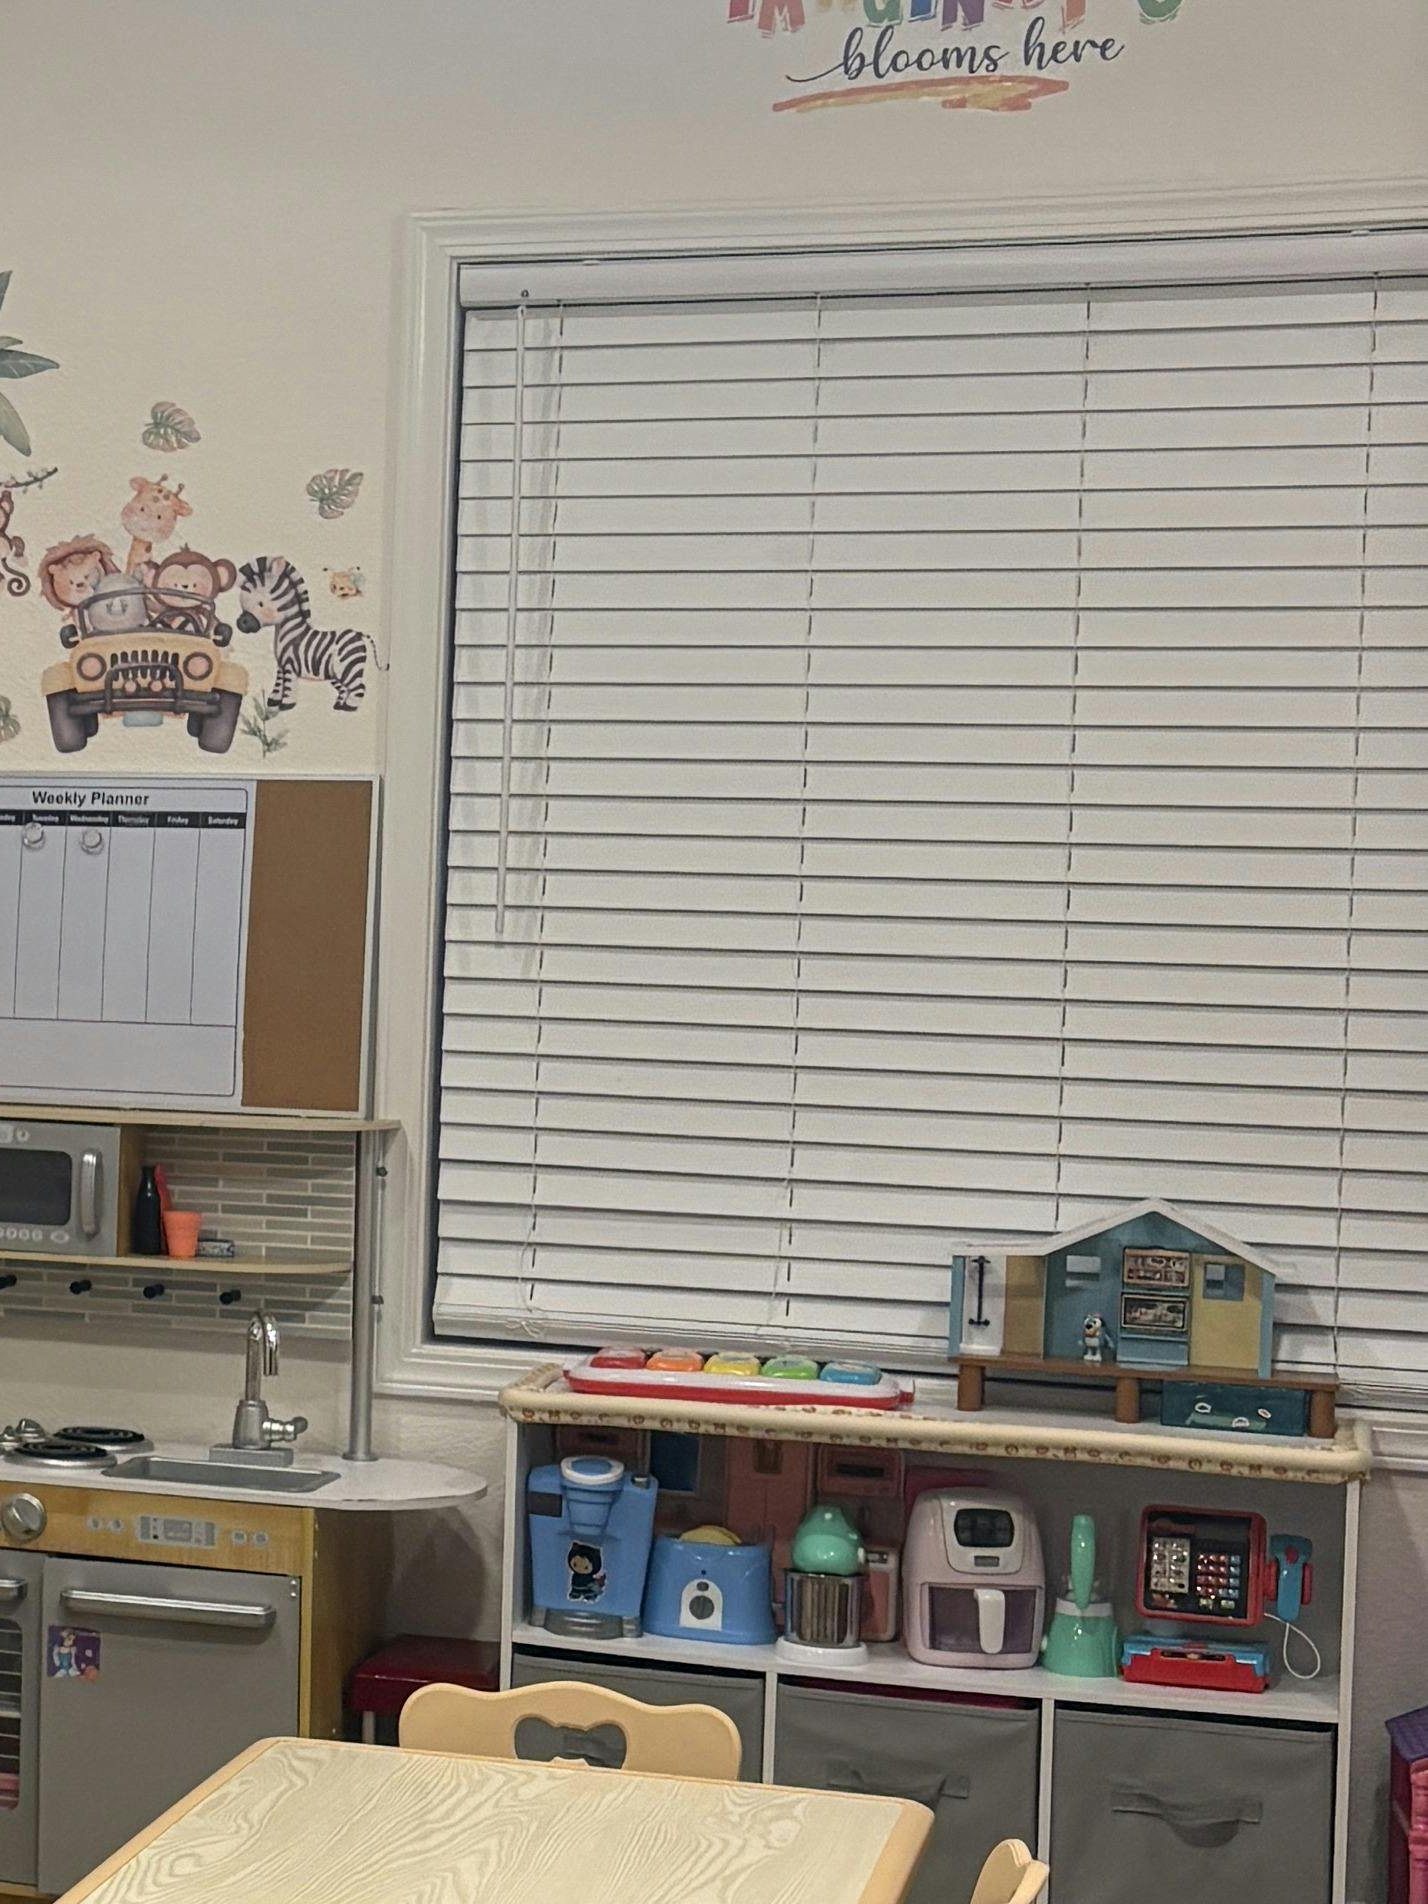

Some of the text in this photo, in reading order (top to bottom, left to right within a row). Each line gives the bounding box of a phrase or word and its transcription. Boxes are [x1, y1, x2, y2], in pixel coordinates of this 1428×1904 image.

[787, 16, 1125, 83] blooms here
[32, 790, 150, 807] Weekly Planner
